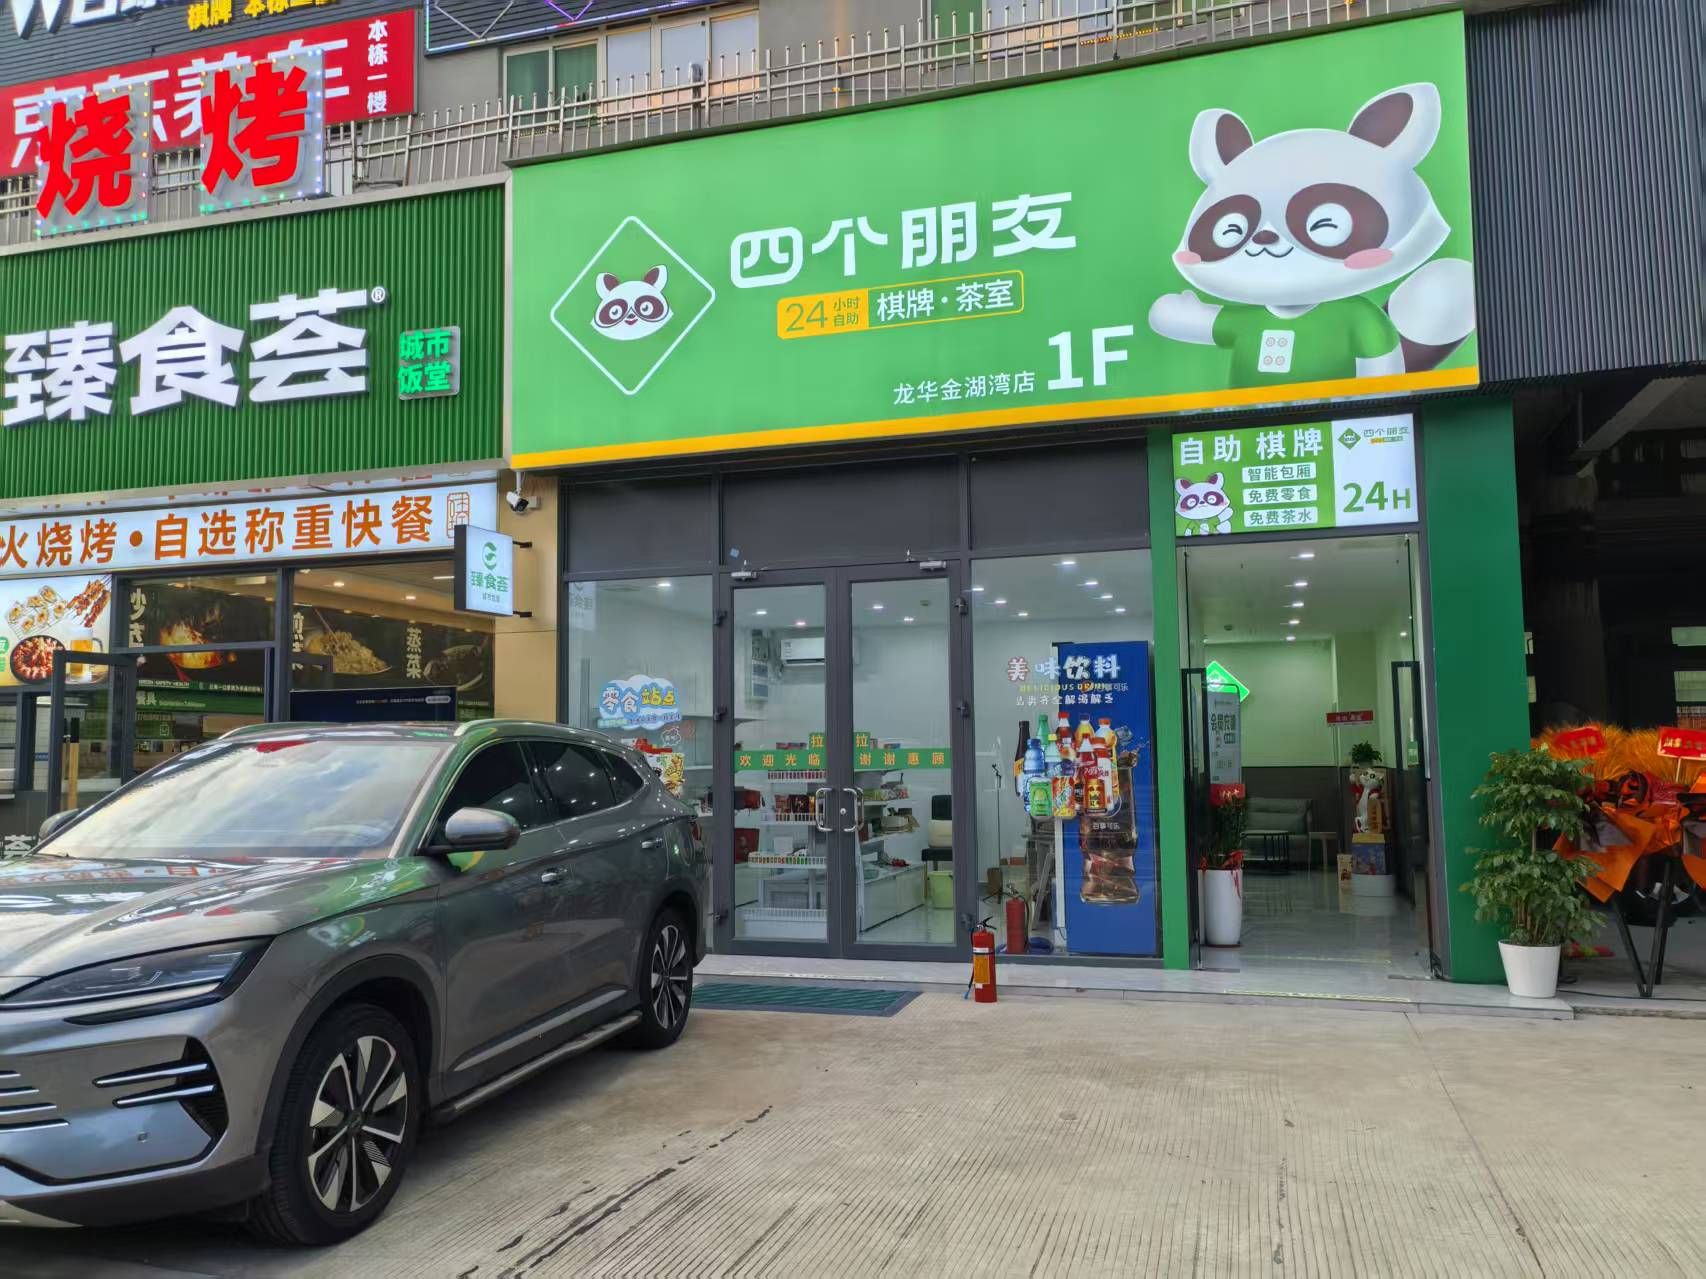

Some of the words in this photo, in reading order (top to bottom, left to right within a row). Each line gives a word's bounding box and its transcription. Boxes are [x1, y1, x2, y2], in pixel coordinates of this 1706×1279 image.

[366, 19, 388, 114] 本栋一楼
[36, 62, 307, 220] 烧烤
[730, 191, 1077, 289] 四个朋友
[785, 300, 829, 333] 24
[833, 296, 860, 313] 小时
[833, 311, 860, 328] 自助
[3, 288, 367, 426] 臻食荟
[399, 327, 452, 361] 城市
[1046, 324, 1135, 391] 1F
[398, 360, 452, 394] 饭堂
[893, 369, 1036, 406] 龙华金湖湾店
[1179, 435, 1241, 466] 自助
[1255, 427, 1324, 461] 棋牌
[1247, 463, 1312, 482] 智能包厢
[1249, 486, 1312, 504] 免费零食
[1342, 480, 1412, 513] 24H
[1249, 507, 1313, 525] 免费茶水
[1007, 654, 1121, 681] 美味饮料
[811, 735, 824, 748] 拉
[856, 734, 868, 748] 拉
[739, 753, 820, 767] 欢迎光临
[859, 751, 945, 766] 谢谢惠顾
